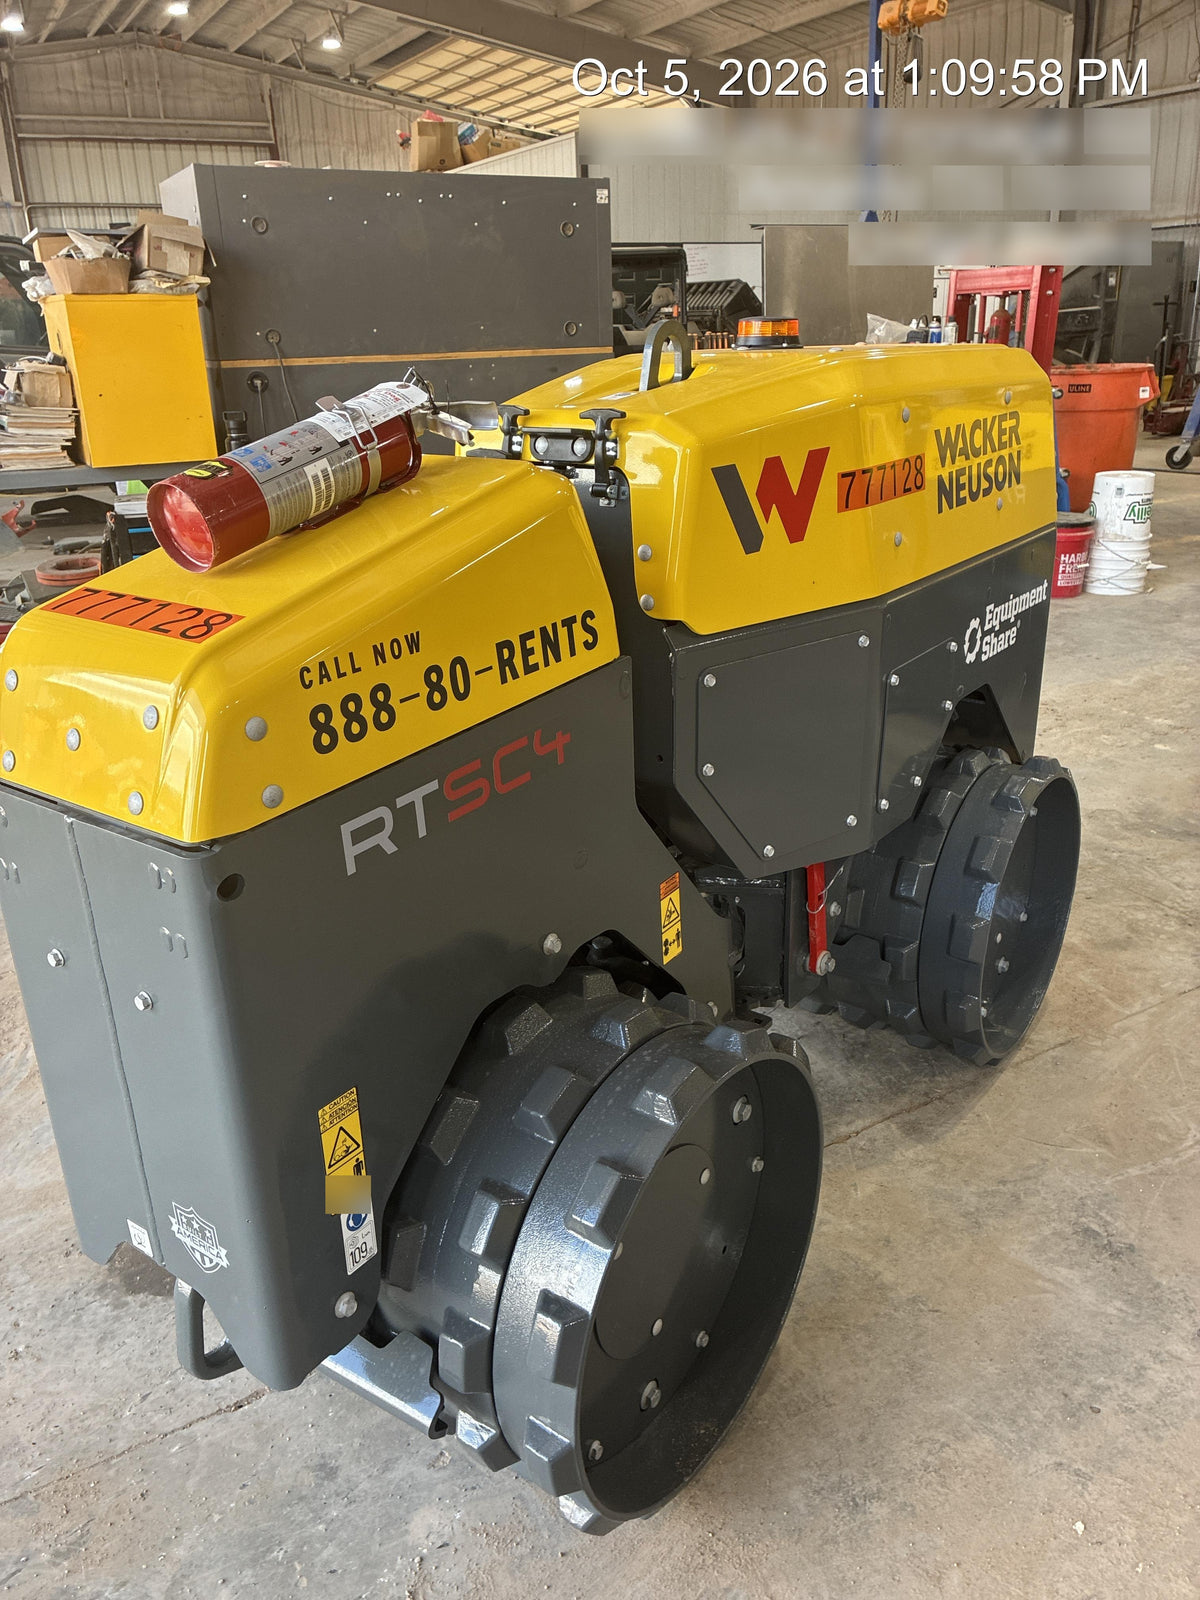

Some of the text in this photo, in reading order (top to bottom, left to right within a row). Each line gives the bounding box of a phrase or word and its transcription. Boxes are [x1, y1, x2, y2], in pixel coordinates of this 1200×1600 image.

[1068, 384, 1091, 393] ULINE
[934, 410, 1021, 468] WACKER
[839, 453, 925, 509] 777128
[937, 449, 1021, 514] NEUSON
[51, 587, 233, 639] 777128
[984, 579, 1048, 632] Equipment
[299, 630, 421, 690] CALL NOW
[308, 609, 599, 755] 888-80-RENTS
[340, 729, 571, 876] RTSC4
[328, 1089, 355, 1110] CAUTION
[328, 1104, 358, 1127] ATTENTION
[177, 1228, 222, 1260] AMERICA
[349, 1241, 368, 1267] 109
